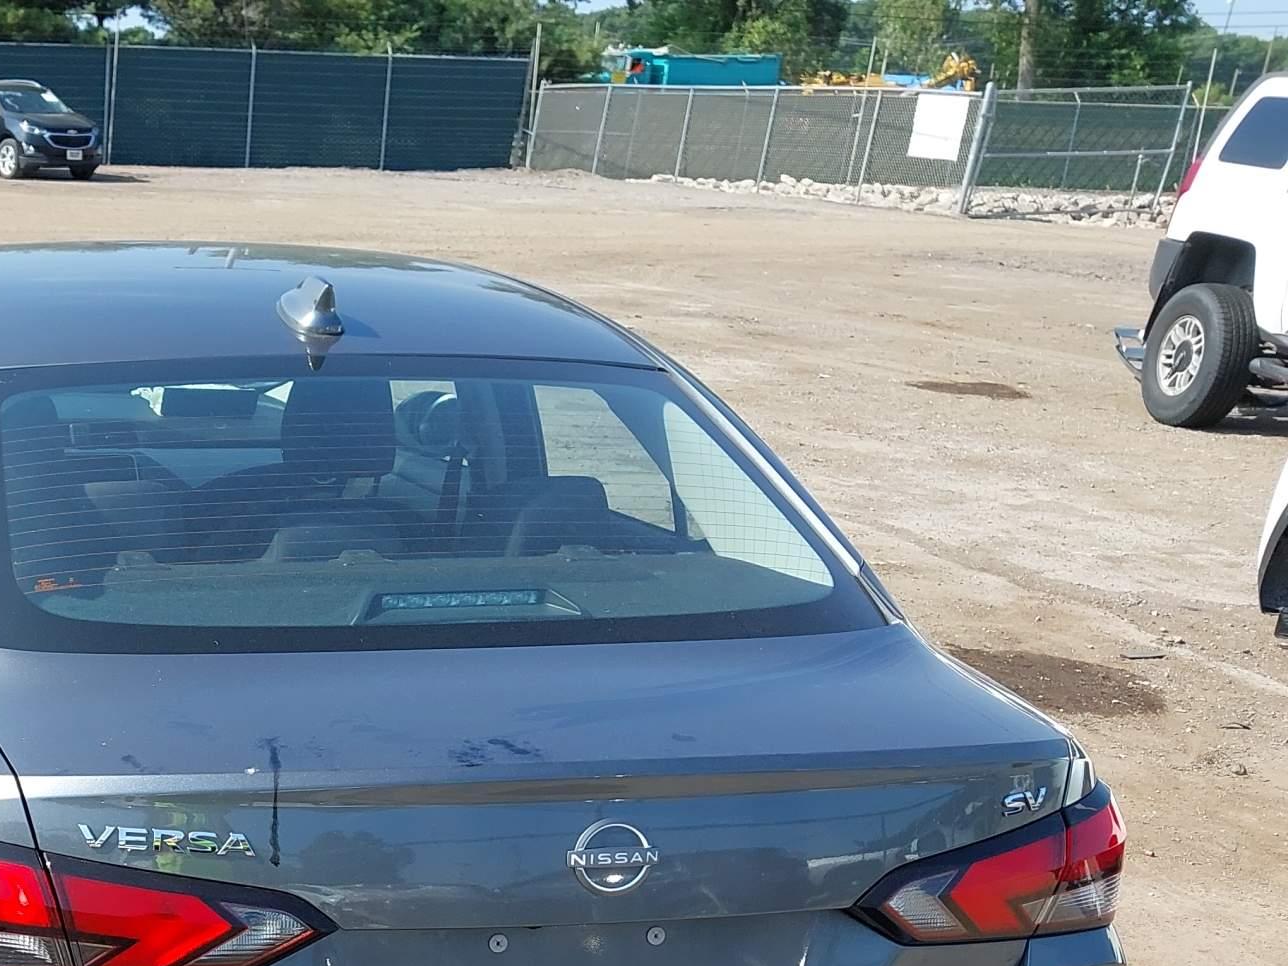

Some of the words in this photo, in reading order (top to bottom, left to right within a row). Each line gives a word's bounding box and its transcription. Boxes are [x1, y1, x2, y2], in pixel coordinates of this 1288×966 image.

[1002, 786, 1046, 817] SV
[78, 823, 256, 857] VERSA
[570, 850, 659, 866] NISSAN
